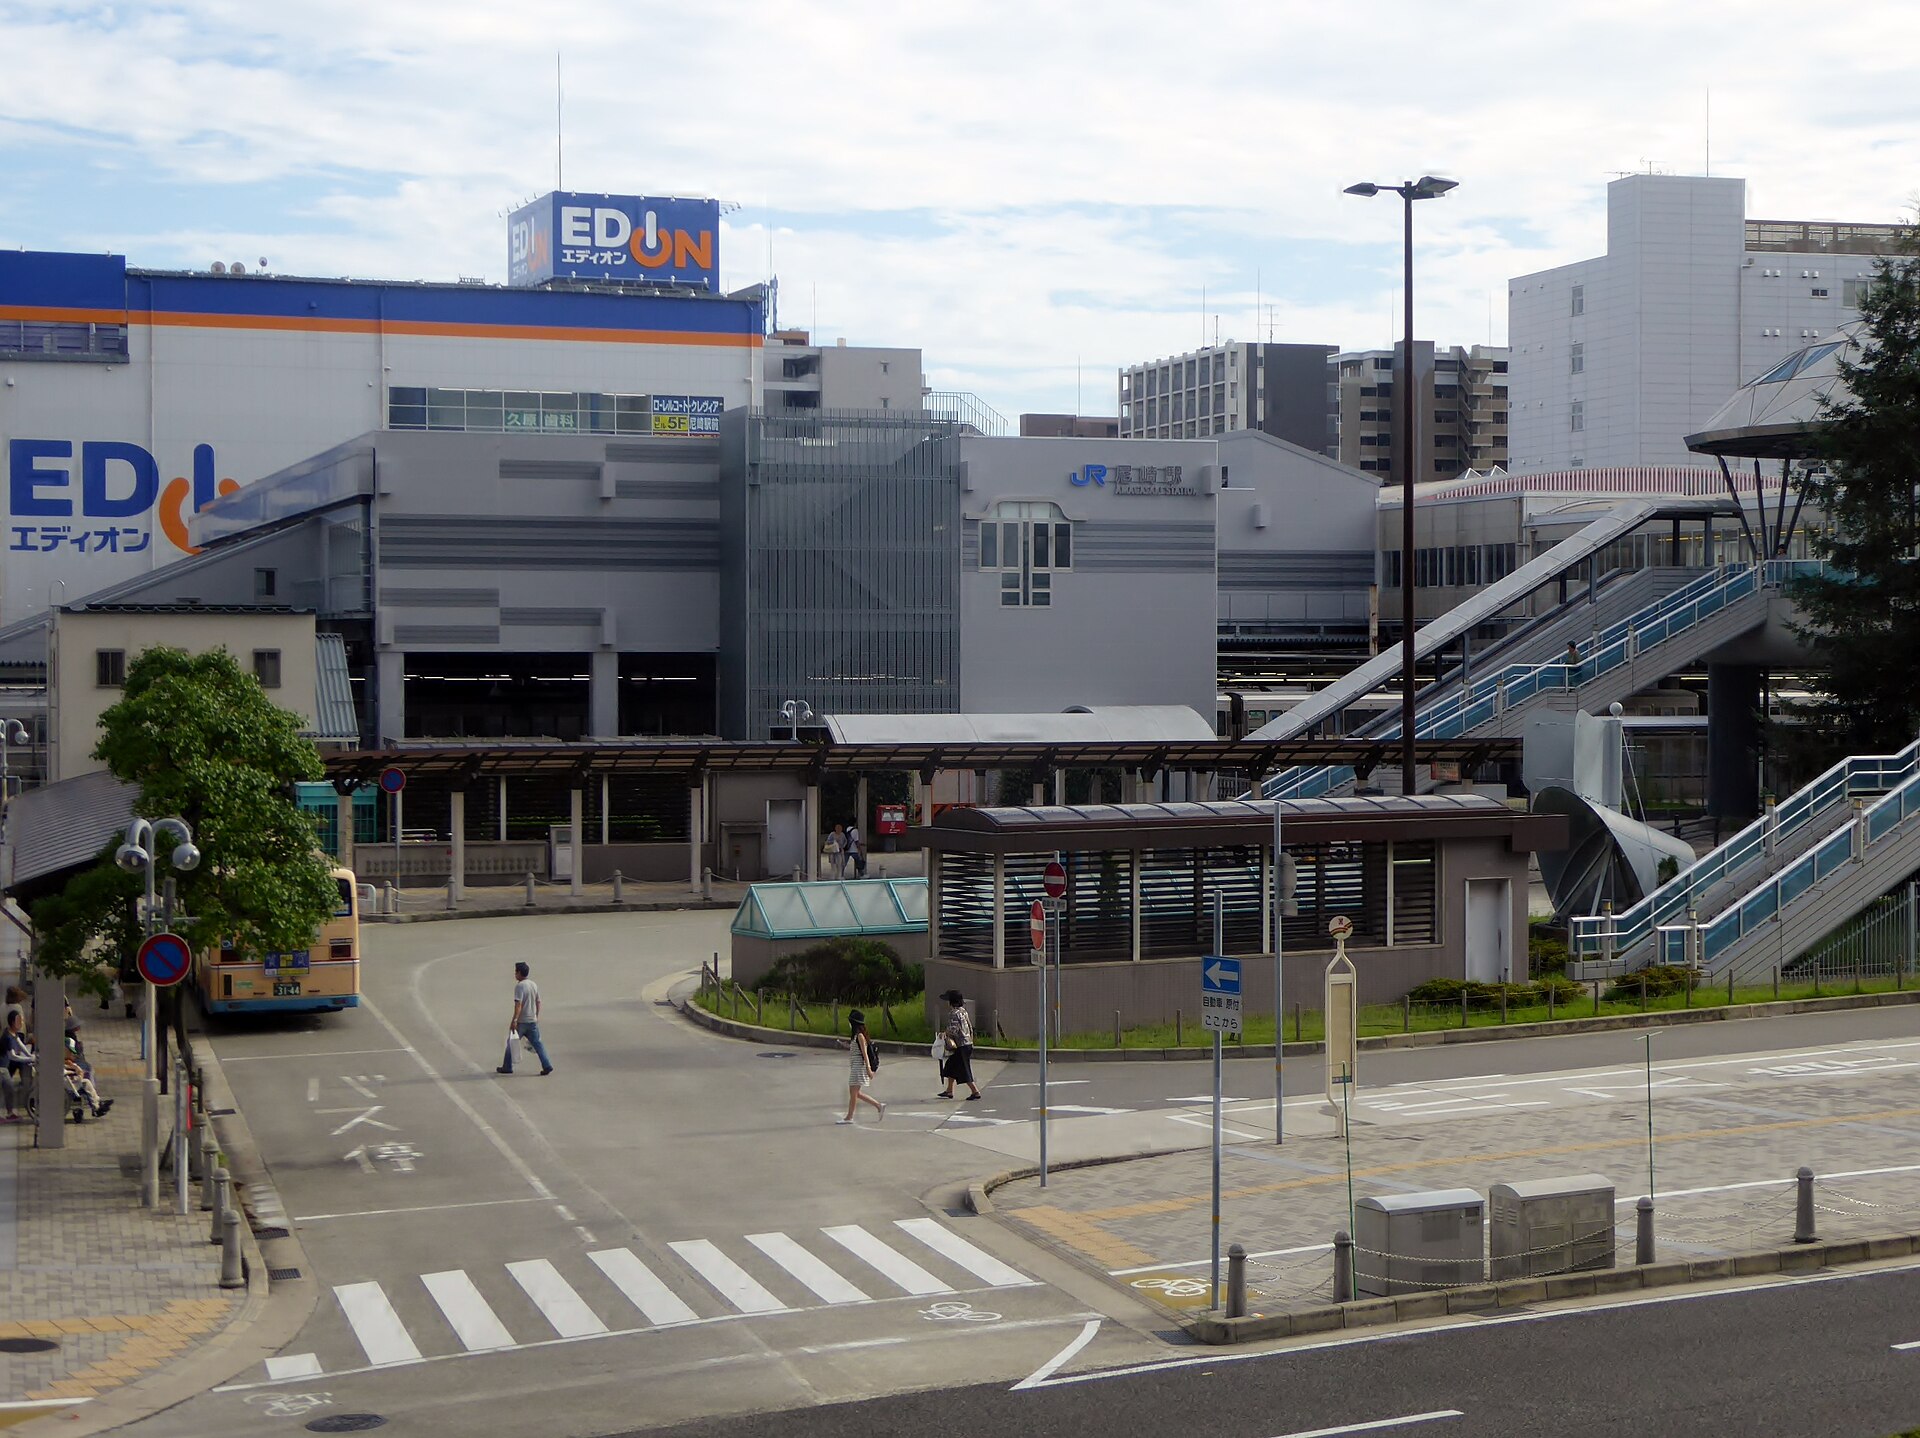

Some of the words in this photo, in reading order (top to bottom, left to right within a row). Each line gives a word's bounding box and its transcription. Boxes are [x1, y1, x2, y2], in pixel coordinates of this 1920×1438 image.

[561, 206, 712, 269] EDION
[561, 249, 627, 265] エディオン
[668, 417, 687, 429] 5F
[1071, 464, 1107, 487] JR
[1116, 465, 1182, 485] 尼崎駅
[10, 525, 150, 552] エディオン
[1203, 996, 1223, 1008] 自動車
[1225, 998, 1240, 1011] 原付
[1205, 1015, 1238, 1029] ここから
